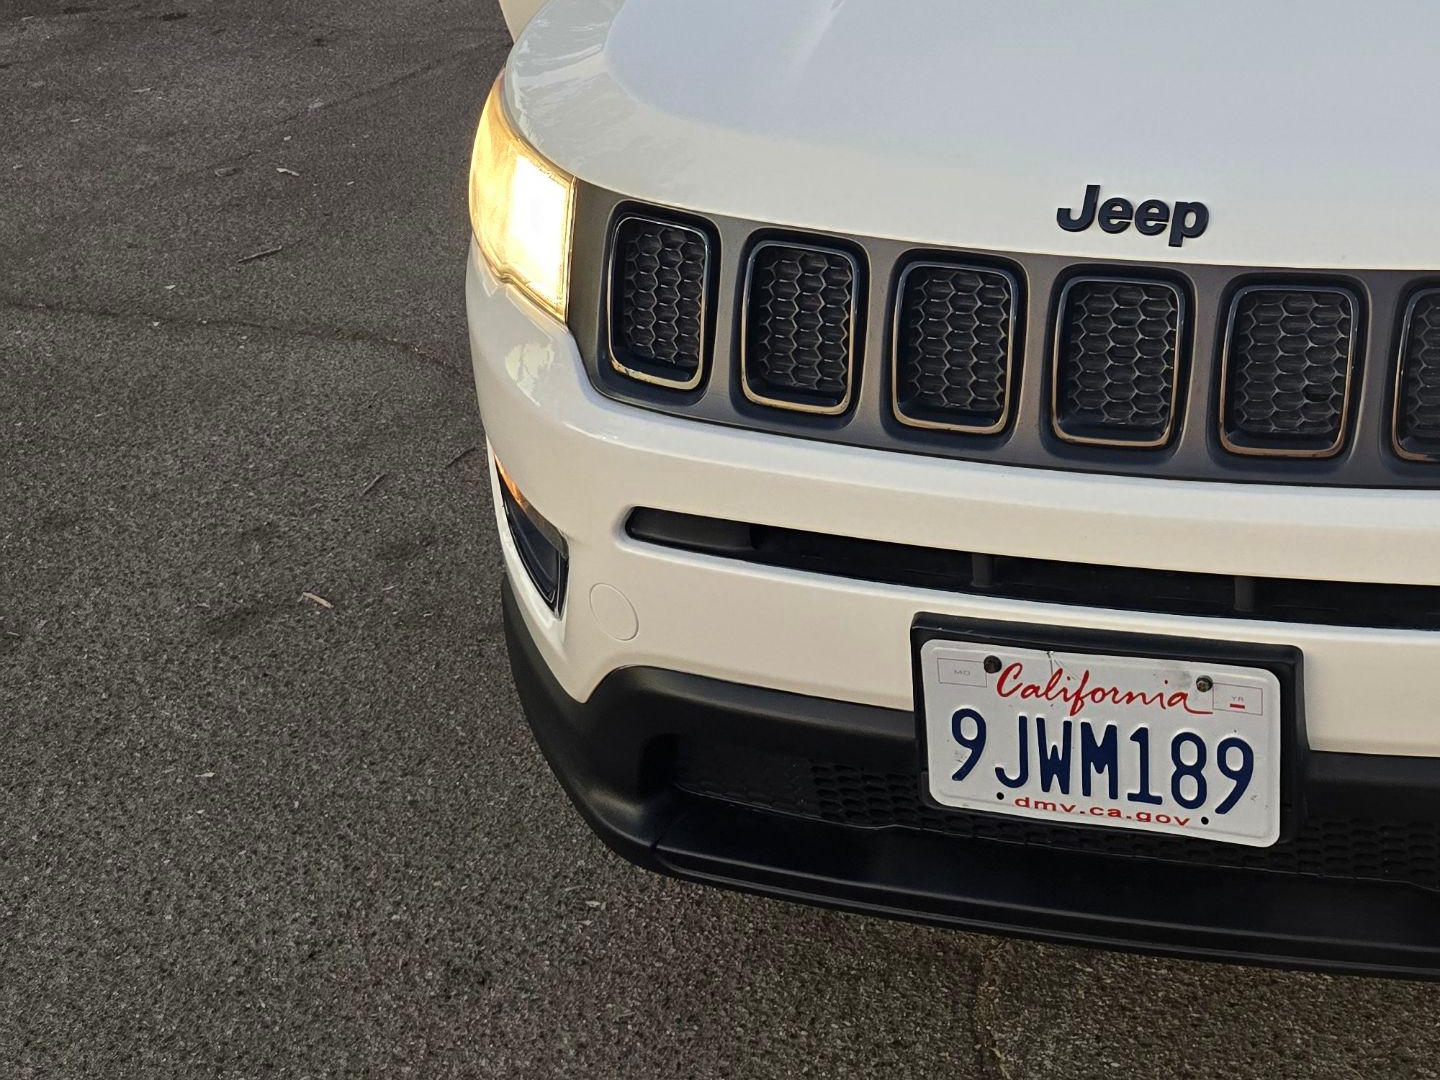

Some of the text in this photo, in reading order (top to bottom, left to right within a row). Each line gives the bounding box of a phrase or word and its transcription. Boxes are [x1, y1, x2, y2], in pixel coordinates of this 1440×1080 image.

[1056, 184, 1210, 248] Jeep
[996, 662, 1213, 716] California
[951, 707, 1255, 815] 9JWM189
[1014, 795, 1191, 826] dmv.ca.gov
